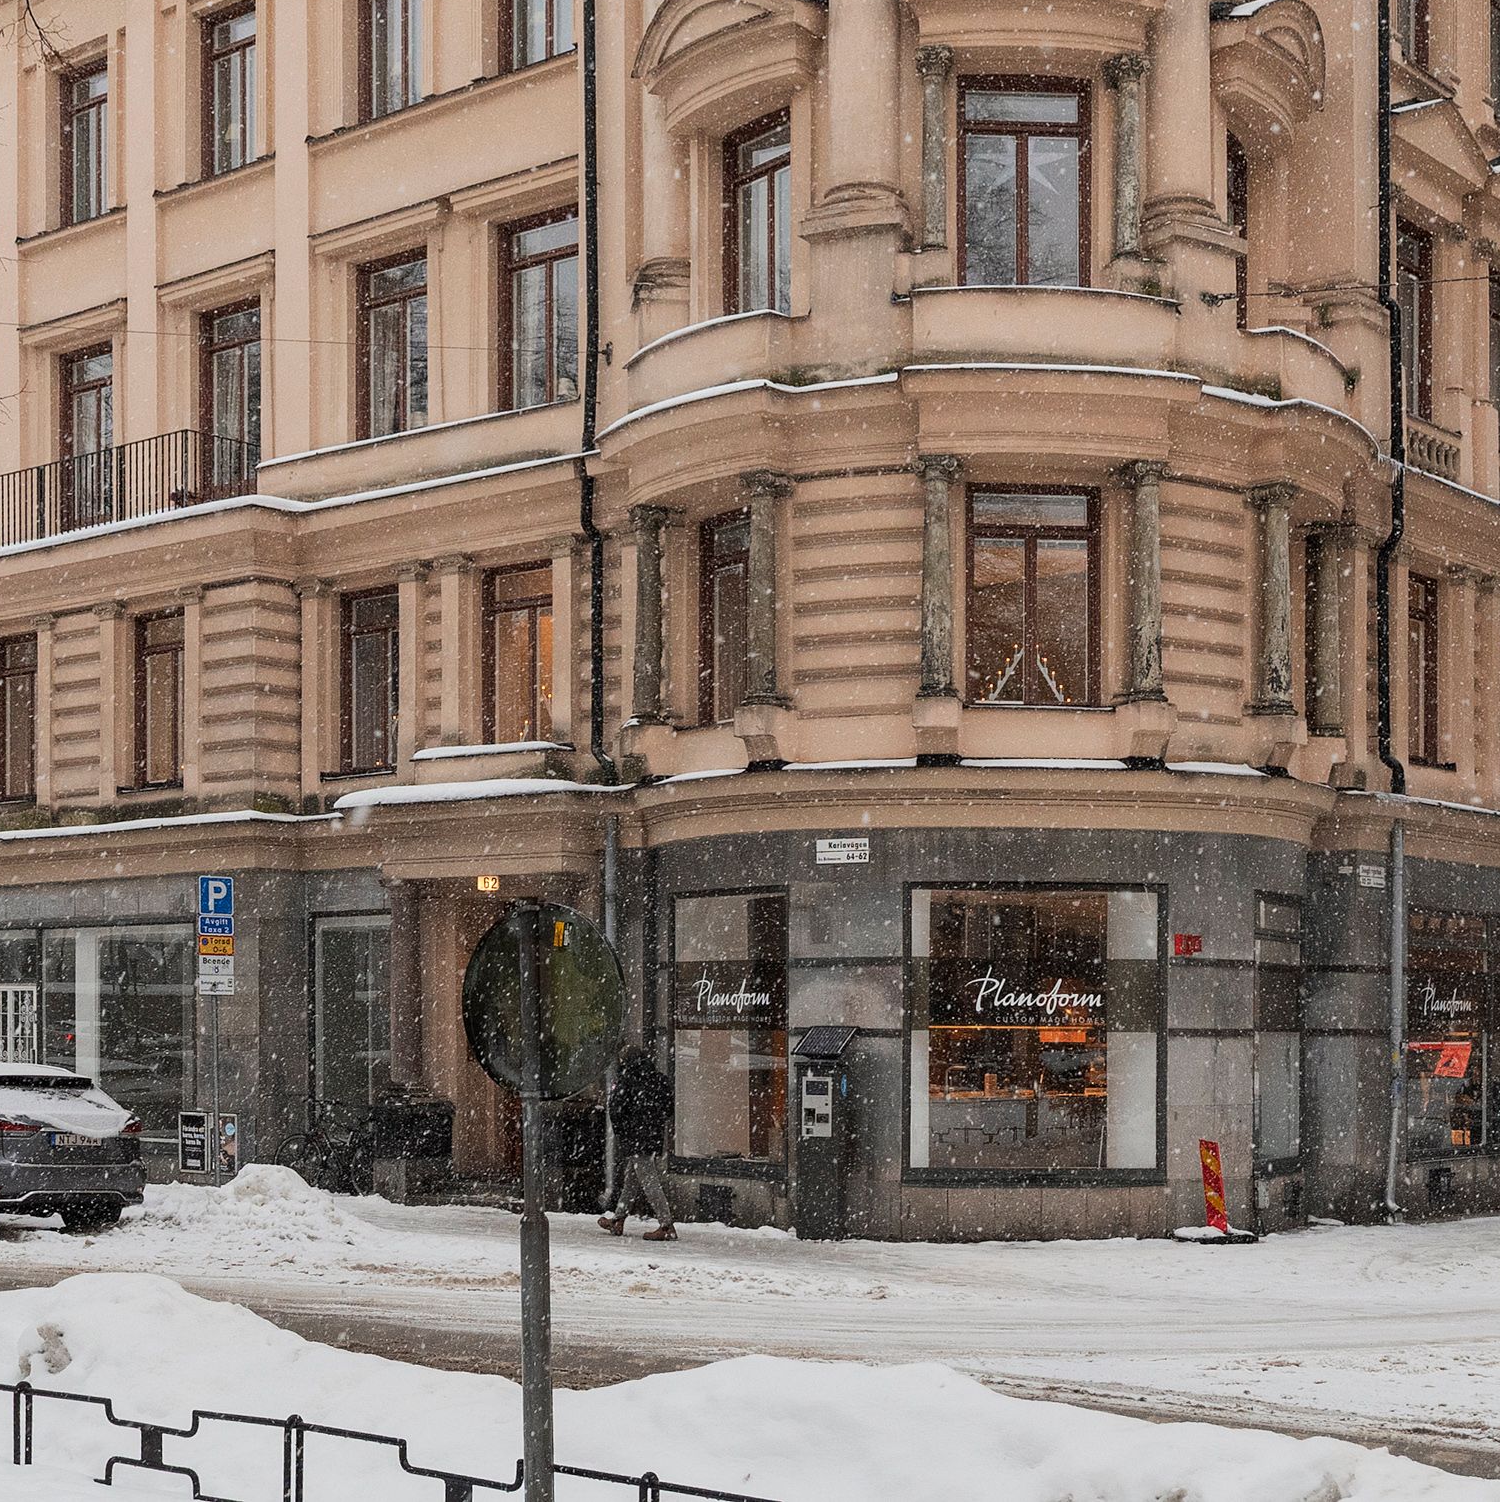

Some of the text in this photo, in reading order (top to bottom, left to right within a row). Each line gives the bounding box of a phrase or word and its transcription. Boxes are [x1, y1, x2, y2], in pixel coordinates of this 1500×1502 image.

[846, 852, 868, 860] 64-62
[483, 877, 498, 889] 62
[208, 881, 227, 911] P
[205, 918, 228, 926] Avgift
[692, 969, 771, 1014] Planoform
[965, 965, 1103, 1015] Planoform
[1421, 977, 1472, 1018] Planoform
[995, 1015, 1106, 1024] CUSTOM MADE HOMES
[59, 1135, 77, 1144] NTJ
